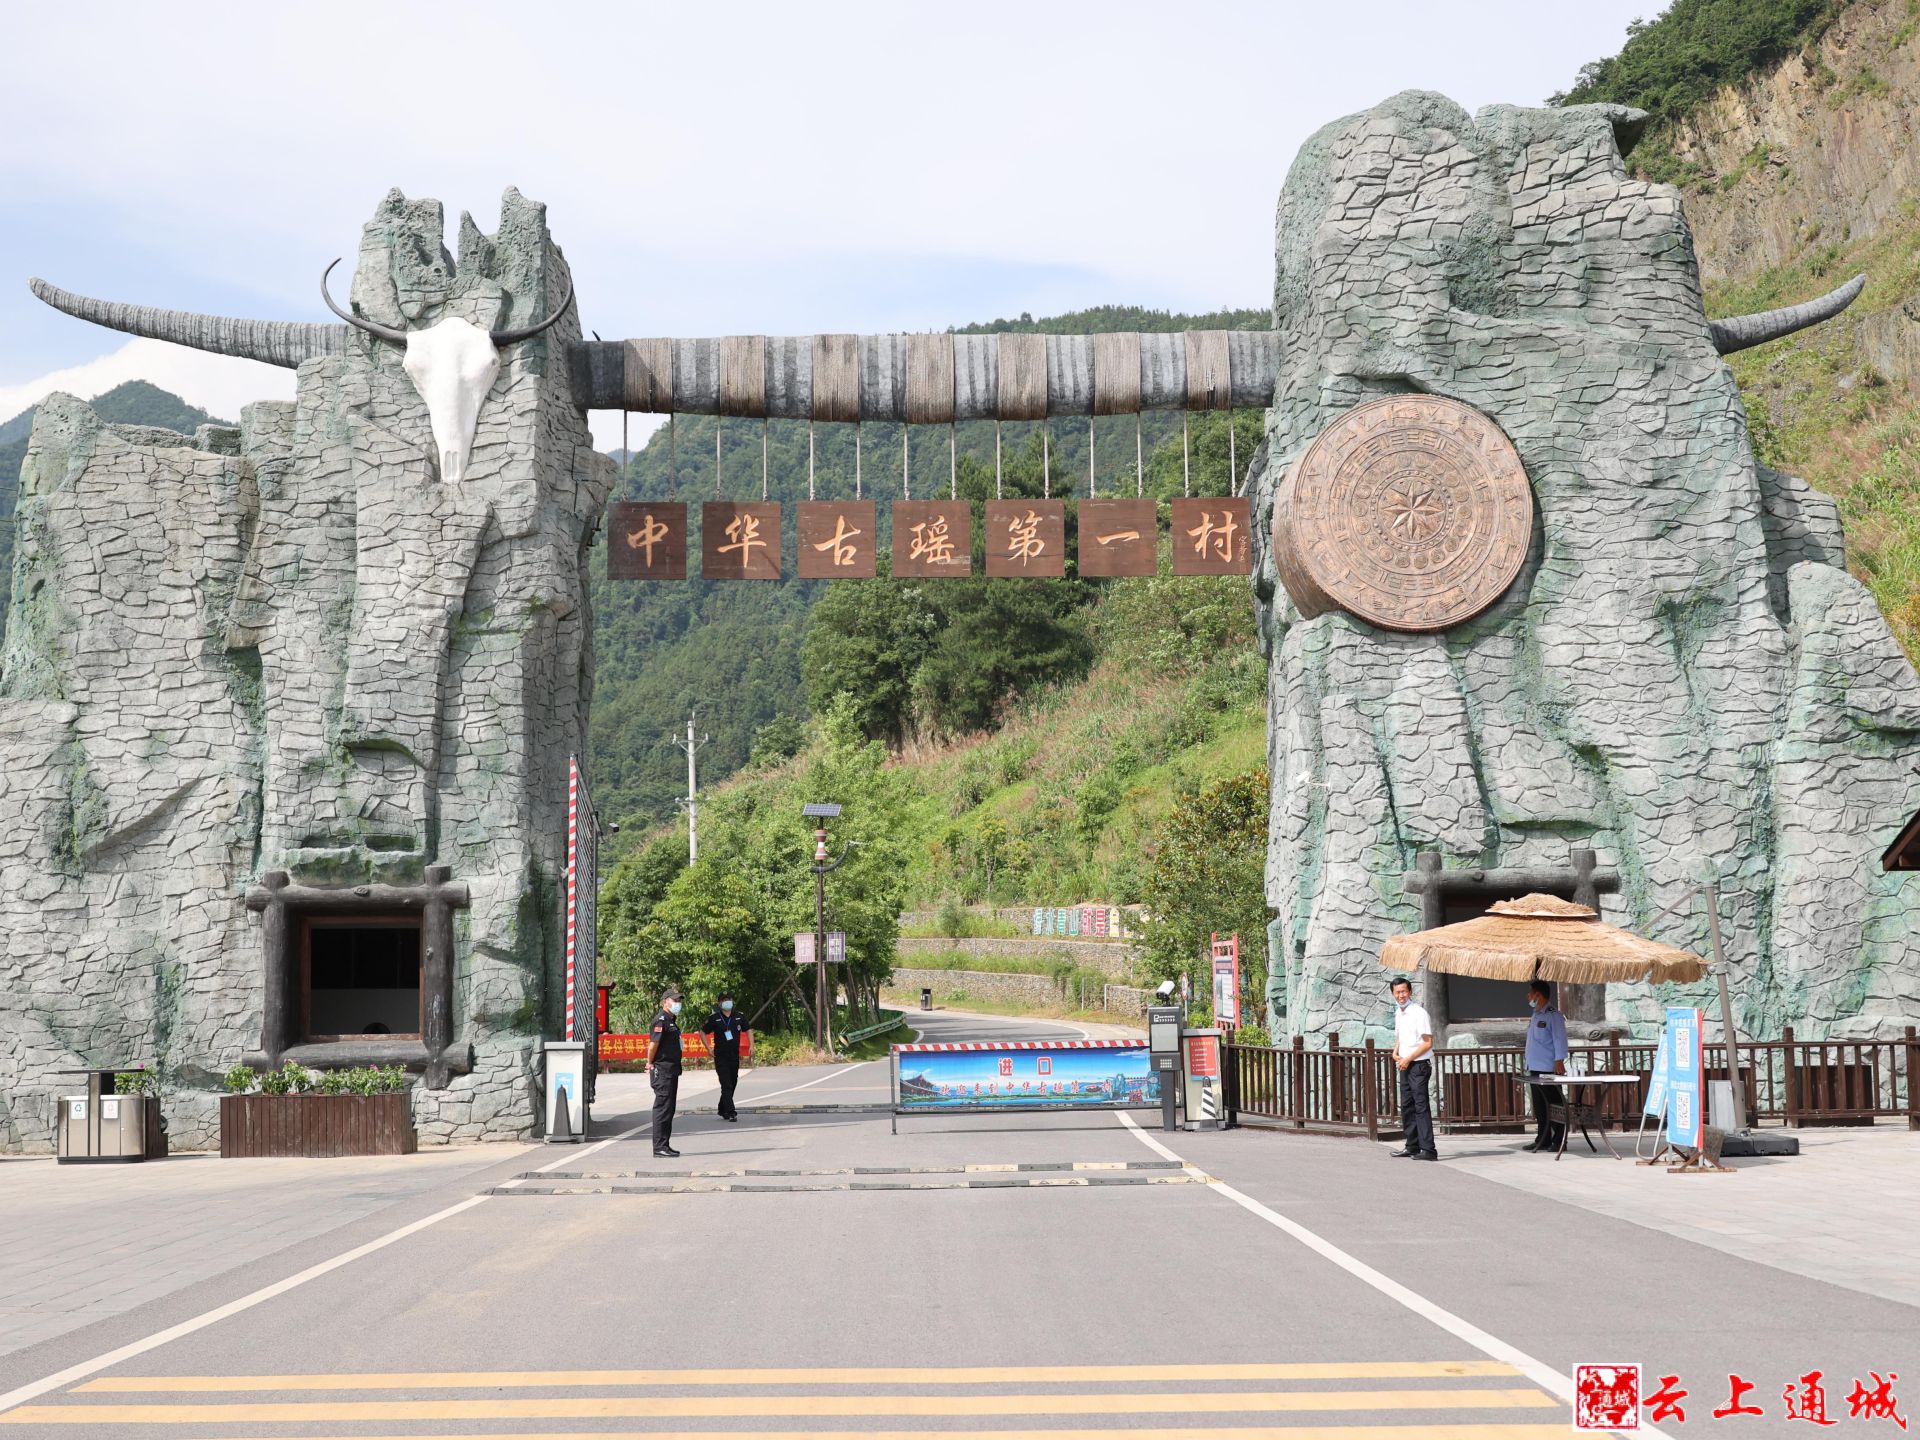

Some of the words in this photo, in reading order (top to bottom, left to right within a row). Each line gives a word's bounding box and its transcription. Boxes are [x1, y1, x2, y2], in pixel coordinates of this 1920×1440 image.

[627, 510, 1238, 568] 中华古瑶第一村
[999, 1057, 1053, 1076] 进口
